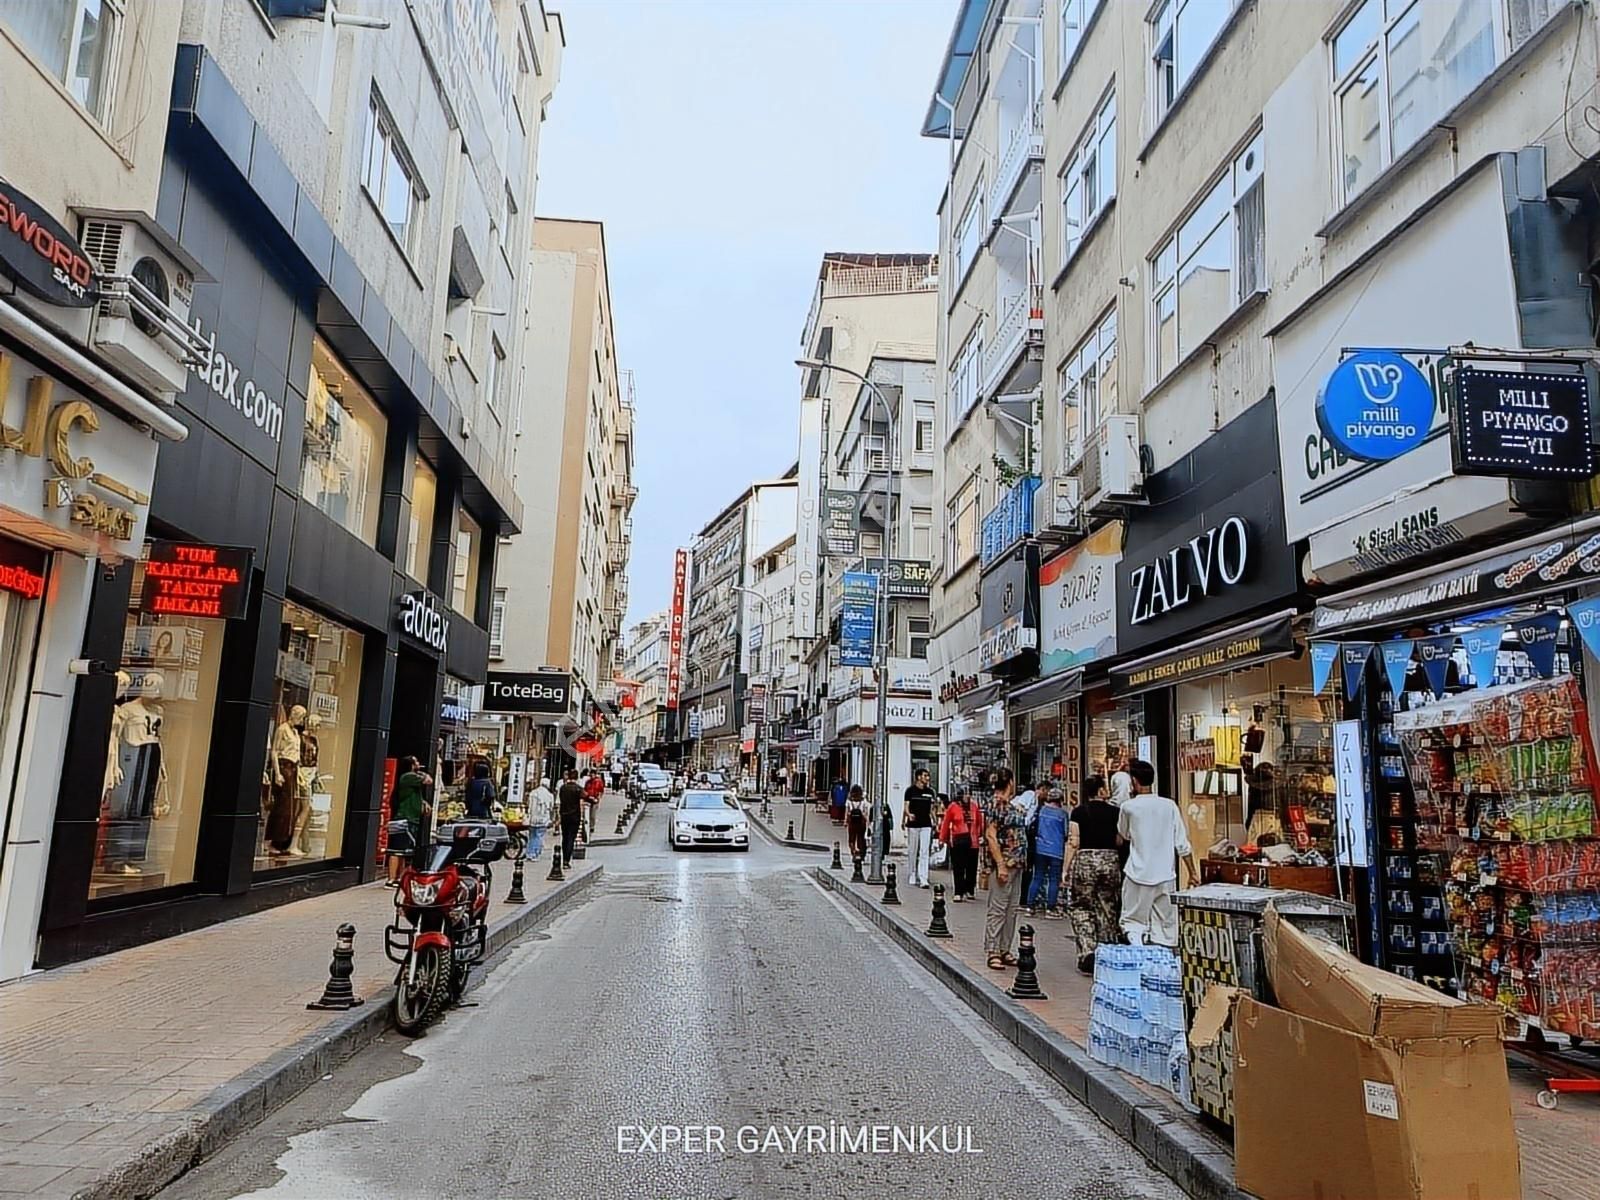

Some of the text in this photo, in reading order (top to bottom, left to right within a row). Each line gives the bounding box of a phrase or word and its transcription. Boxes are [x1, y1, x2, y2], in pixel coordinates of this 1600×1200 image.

[52, 266, 88, 300] SAAT
[186, 317, 284, 442] dax.com
[1499, 388, 1550, 409] MILLI
[1363, 407, 1399, 422] milli
[1482, 410, 1569, 433] PIYANGO
[1347, 421, 1416, 439] piyango
[1368, 521, 1399, 549] Sisal
[176, 547, 217, 564] TUM
[148, 562, 240, 583] KARTLARA
[1130, 517, 1247, 625] ZALVO
[160, 579, 223, 598] TAKSIT
[154, 596, 221, 615] IMKANI
[404, 592, 449, 653] addax
[669, 614, 683, 701] OTOPARK
[1153, 661, 1177, 680] ERKEK
[1176, 655, 1202, 677] ÇANTA
[1201, 645, 1226, 667] VALİZ
[1226, 636, 1261, 659] CÜZDAN
[490, 681, 564, 702] ToteBag
